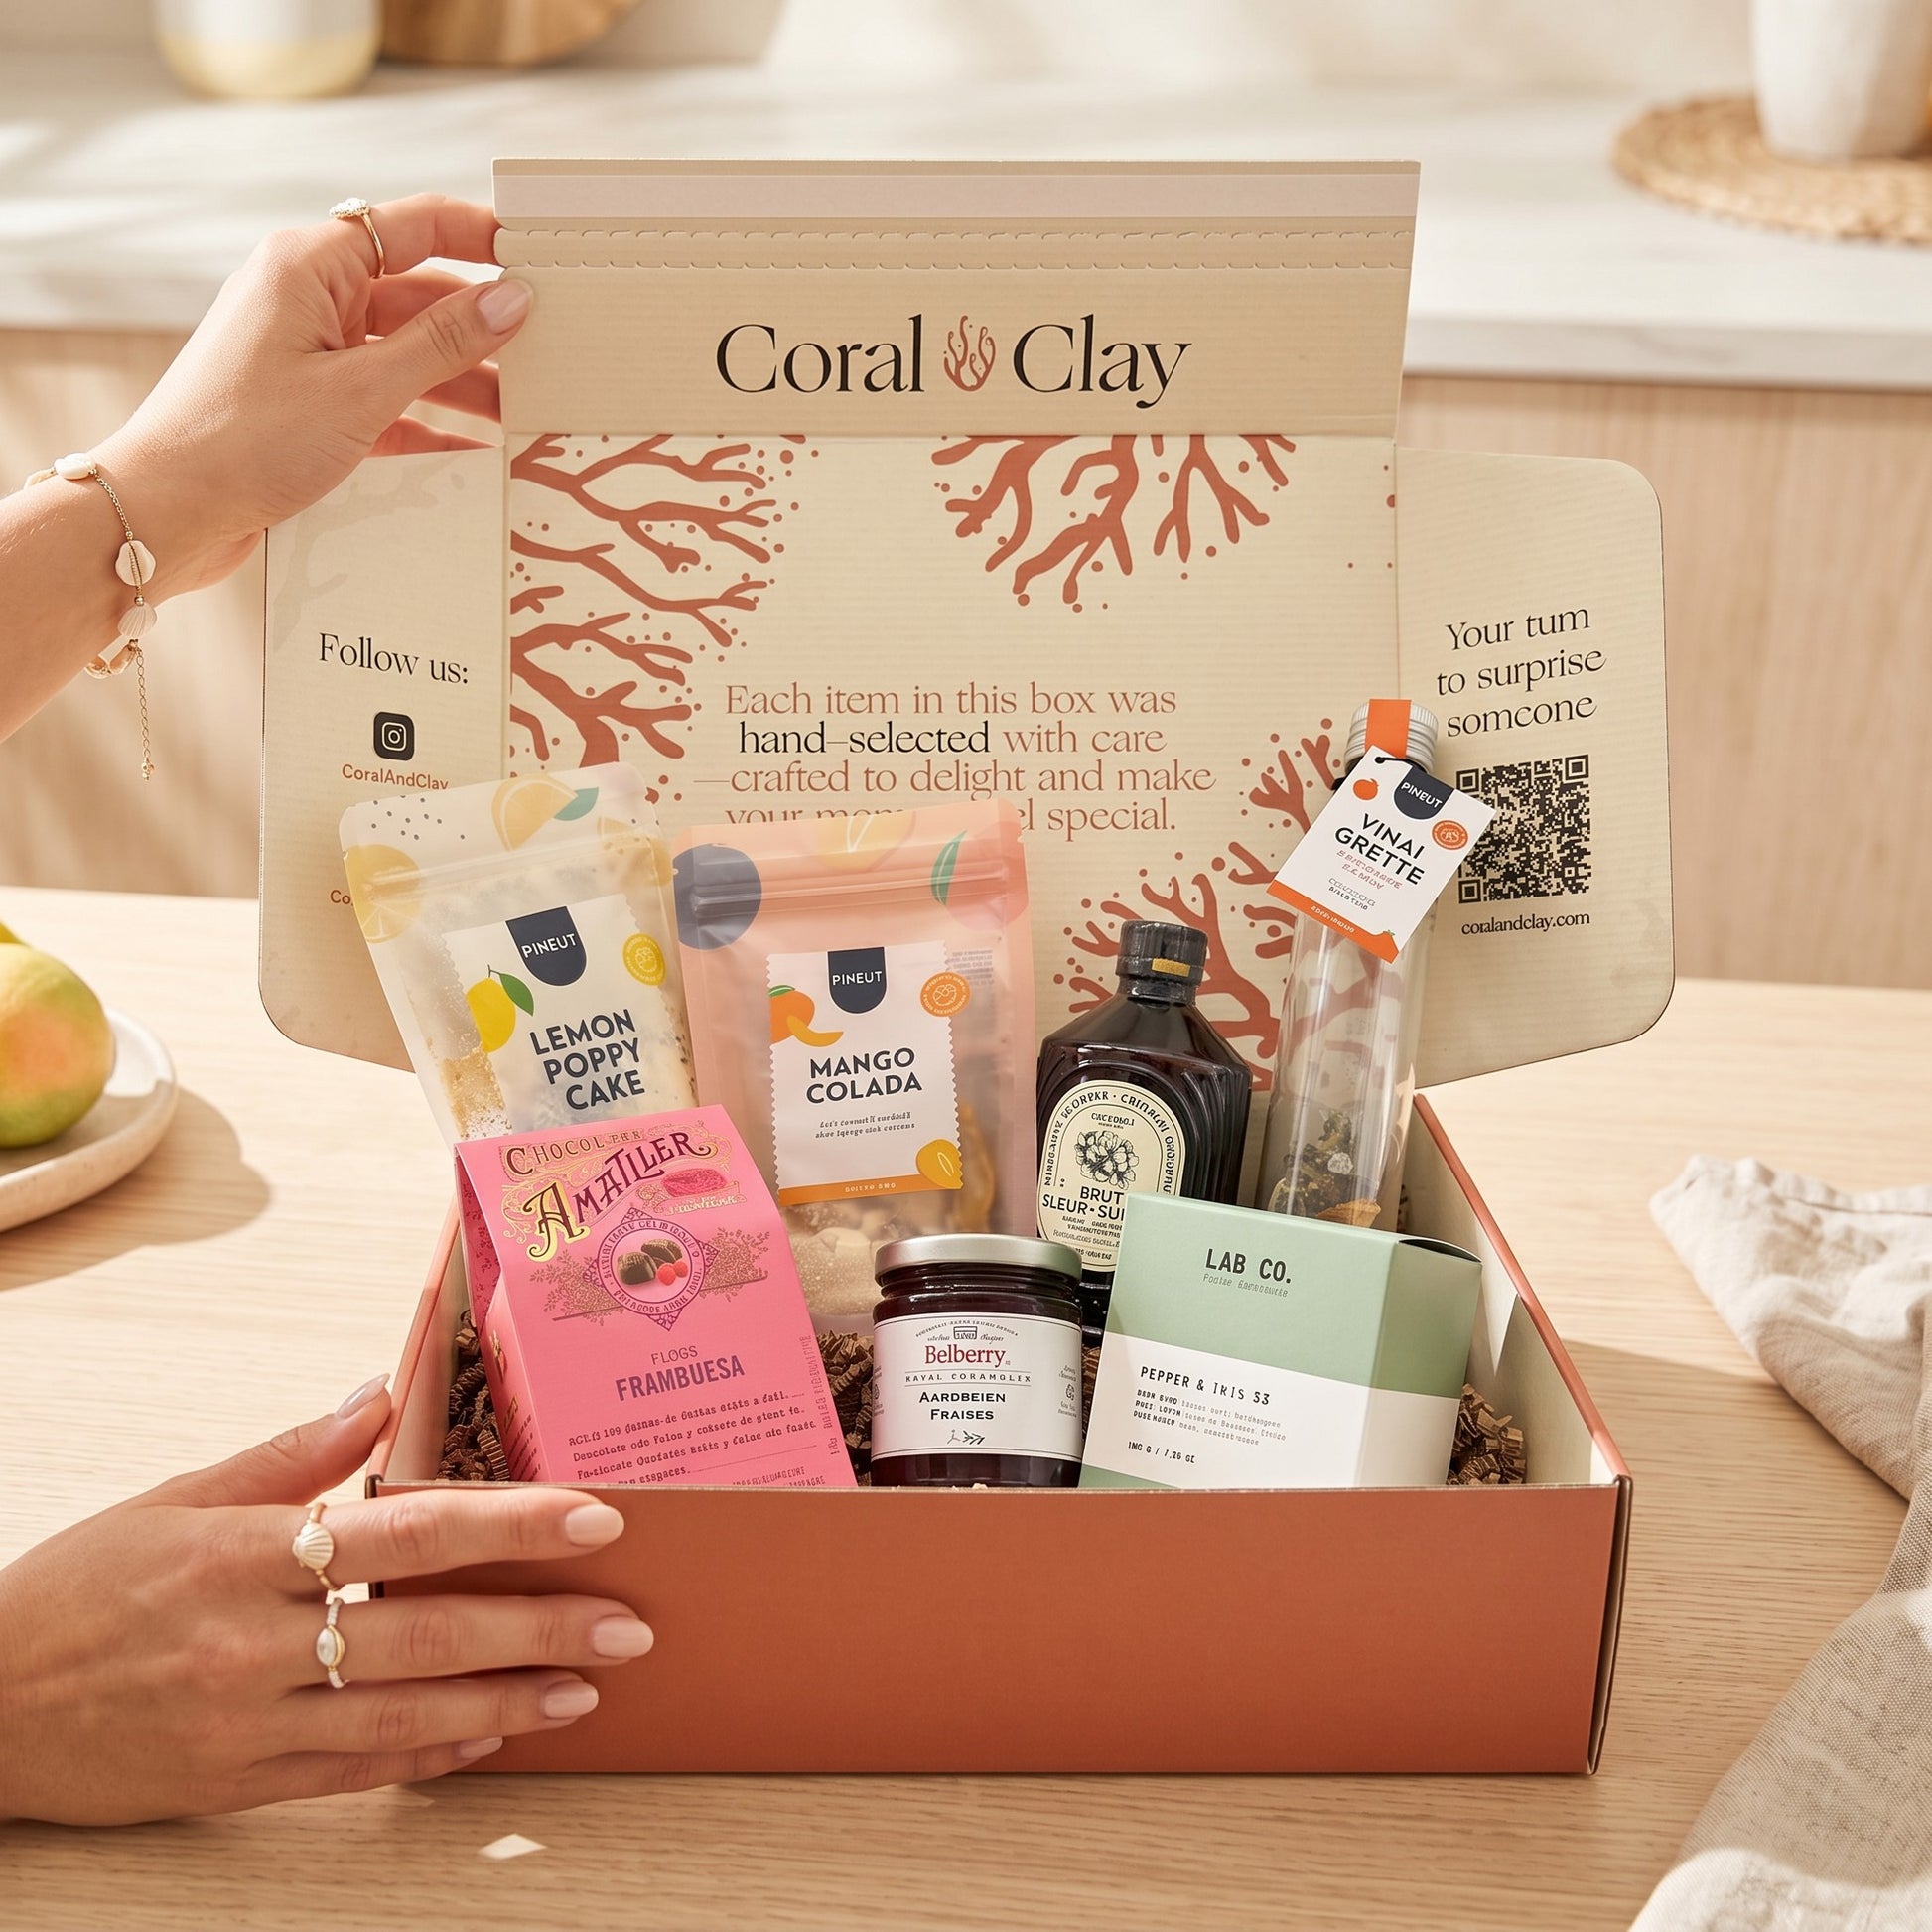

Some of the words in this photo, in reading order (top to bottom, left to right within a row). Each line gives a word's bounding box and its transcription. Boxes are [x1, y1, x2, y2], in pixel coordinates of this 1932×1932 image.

[716, 314, 925, 394] Coral
[1013, 314, 1192, 409] Clay
[1446, 621, 1515, 651] Your
[319, 632, 420, 676] Follow
[429, 659, 468, 684] us:
[1437, 672, 1466, 696] to
[1477, 649, 1607, 692] surprise
[725, 681, 812, 715] Each
[825, 685, 900, 715] item
[913, 685, 944, 715] in
[956, 681, 1018, 714] this
[1030, 681, 1097, 714] box
[1107, 690, 1176, 714] was
[1003, 719, 1079, 753] with
[1091, 729, 1168, 753] care
[864, 766, 897, 792] to
[910, 758, 1027, 801] delight
[1038, 758, 1104, 791] and
[1117, 758, 1217, 792] make
[1047, 796, 1176, 843] special.
[1362, 812, 1426, 860] VINAI
[1334, 826, 1426, 886] GRETTE
[1461, 913, 1590, 935] coralandclay.com
[521, 933, 576, 958] PINEUT
[832, 970, 883, 986] PINEUT
[529, 1009, 636, 1056] LEMON
[543, 1037, 640, 1084] POPPY
[809, 1047, 915, 1079] MANGO
[566, 1069, 645, 1110] CAKE
[806, 1072, 923, 1104] COLADA
[1080, 1185, 1125, 1205] BRUT
[1205, 1248, 1246, 1274] LAB
[1259, 1258, 1291, 1284] CO.
[924, 1344, 1006, 1368] Belberry
[615, 1355, 746, 1401] FRAMBUESA
[1140, 1366, 1190, 1388] PEPPER
[1196, 1379, 1204, 1391] &
[930, 1409, 994, 1421] FRAISES
